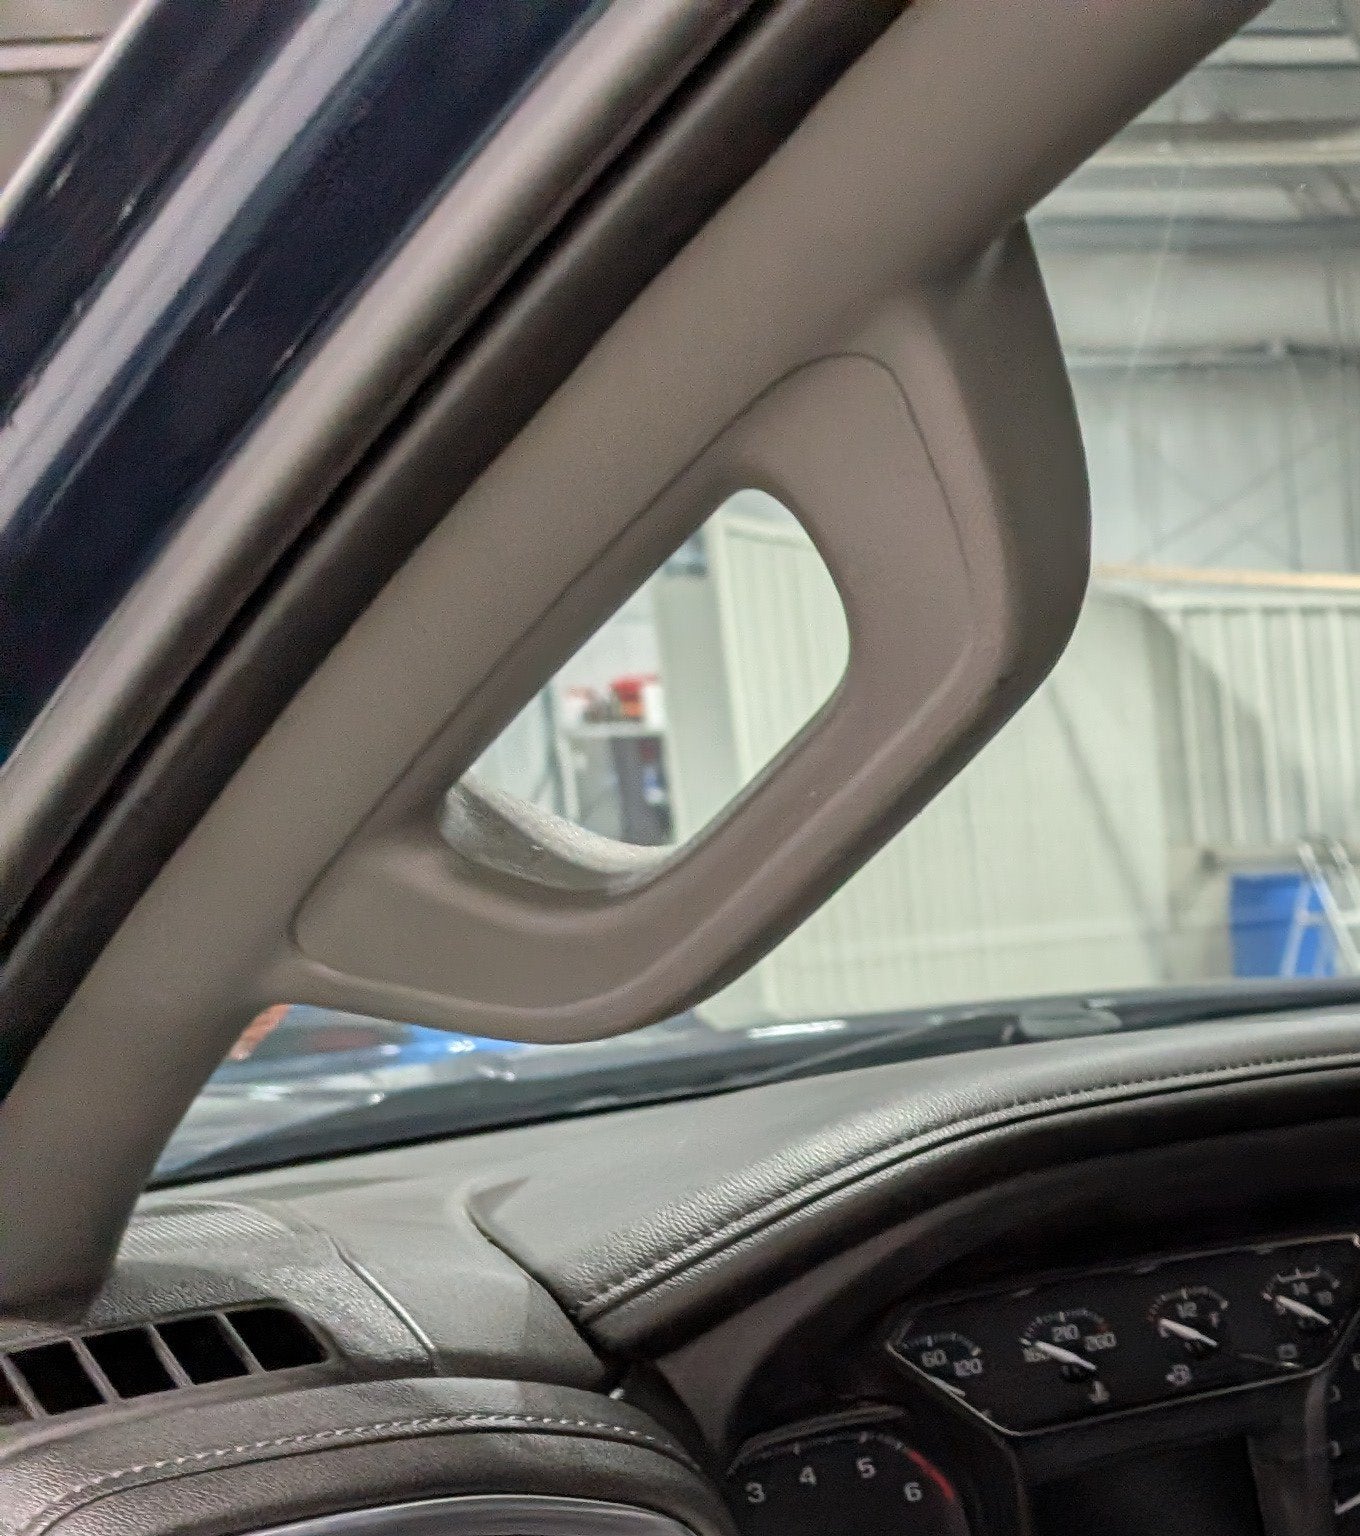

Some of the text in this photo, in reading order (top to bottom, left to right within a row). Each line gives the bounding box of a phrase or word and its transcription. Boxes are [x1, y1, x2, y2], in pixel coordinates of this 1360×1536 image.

[920, 1348, 947, 1368] 60
[800, 1465, 817, 1486] 4
[856, 1457, 876, 1479] 5
[745, 1481, 765, 1503] 3
[903, 1481, 923, 1502] 6
